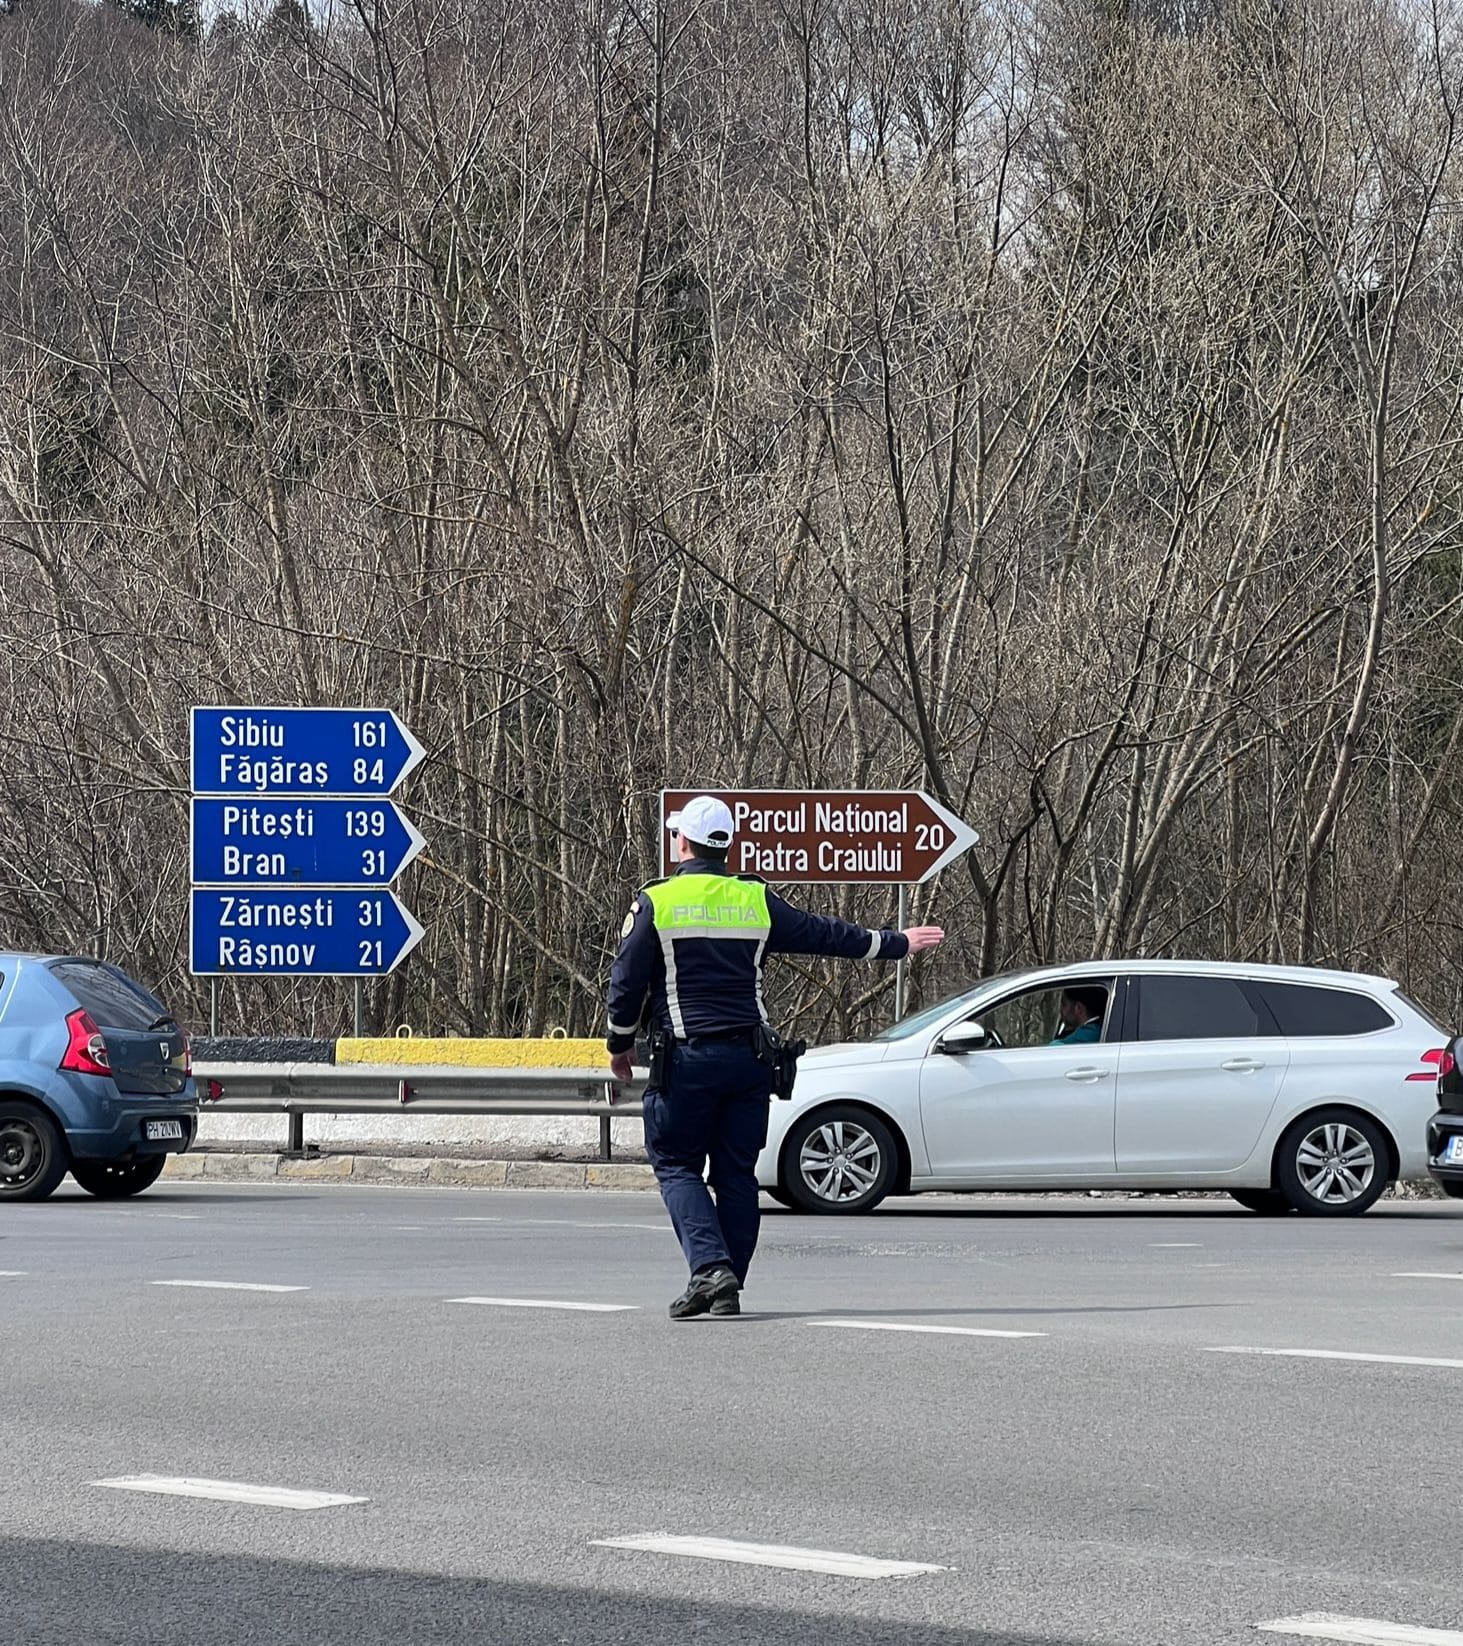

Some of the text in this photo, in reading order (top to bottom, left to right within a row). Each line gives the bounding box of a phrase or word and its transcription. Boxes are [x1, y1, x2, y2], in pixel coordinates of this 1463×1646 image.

[220, 716, 386, 748] Sibiu 161
[220, 754, 384, 791] Făgăraș 84
[223, 806, 385, 839] Pitești 139
[734, 801, 907, 838] Parcul Național
[914, 824, 944, 850] 20
[223, 846, 386, 876] Bran 31
[740, 841, 902, 872] Piatra Craiului
[219, 896, 382, 930] Zărnești 31
[218, 936, 382, 969] Râșnov 21
